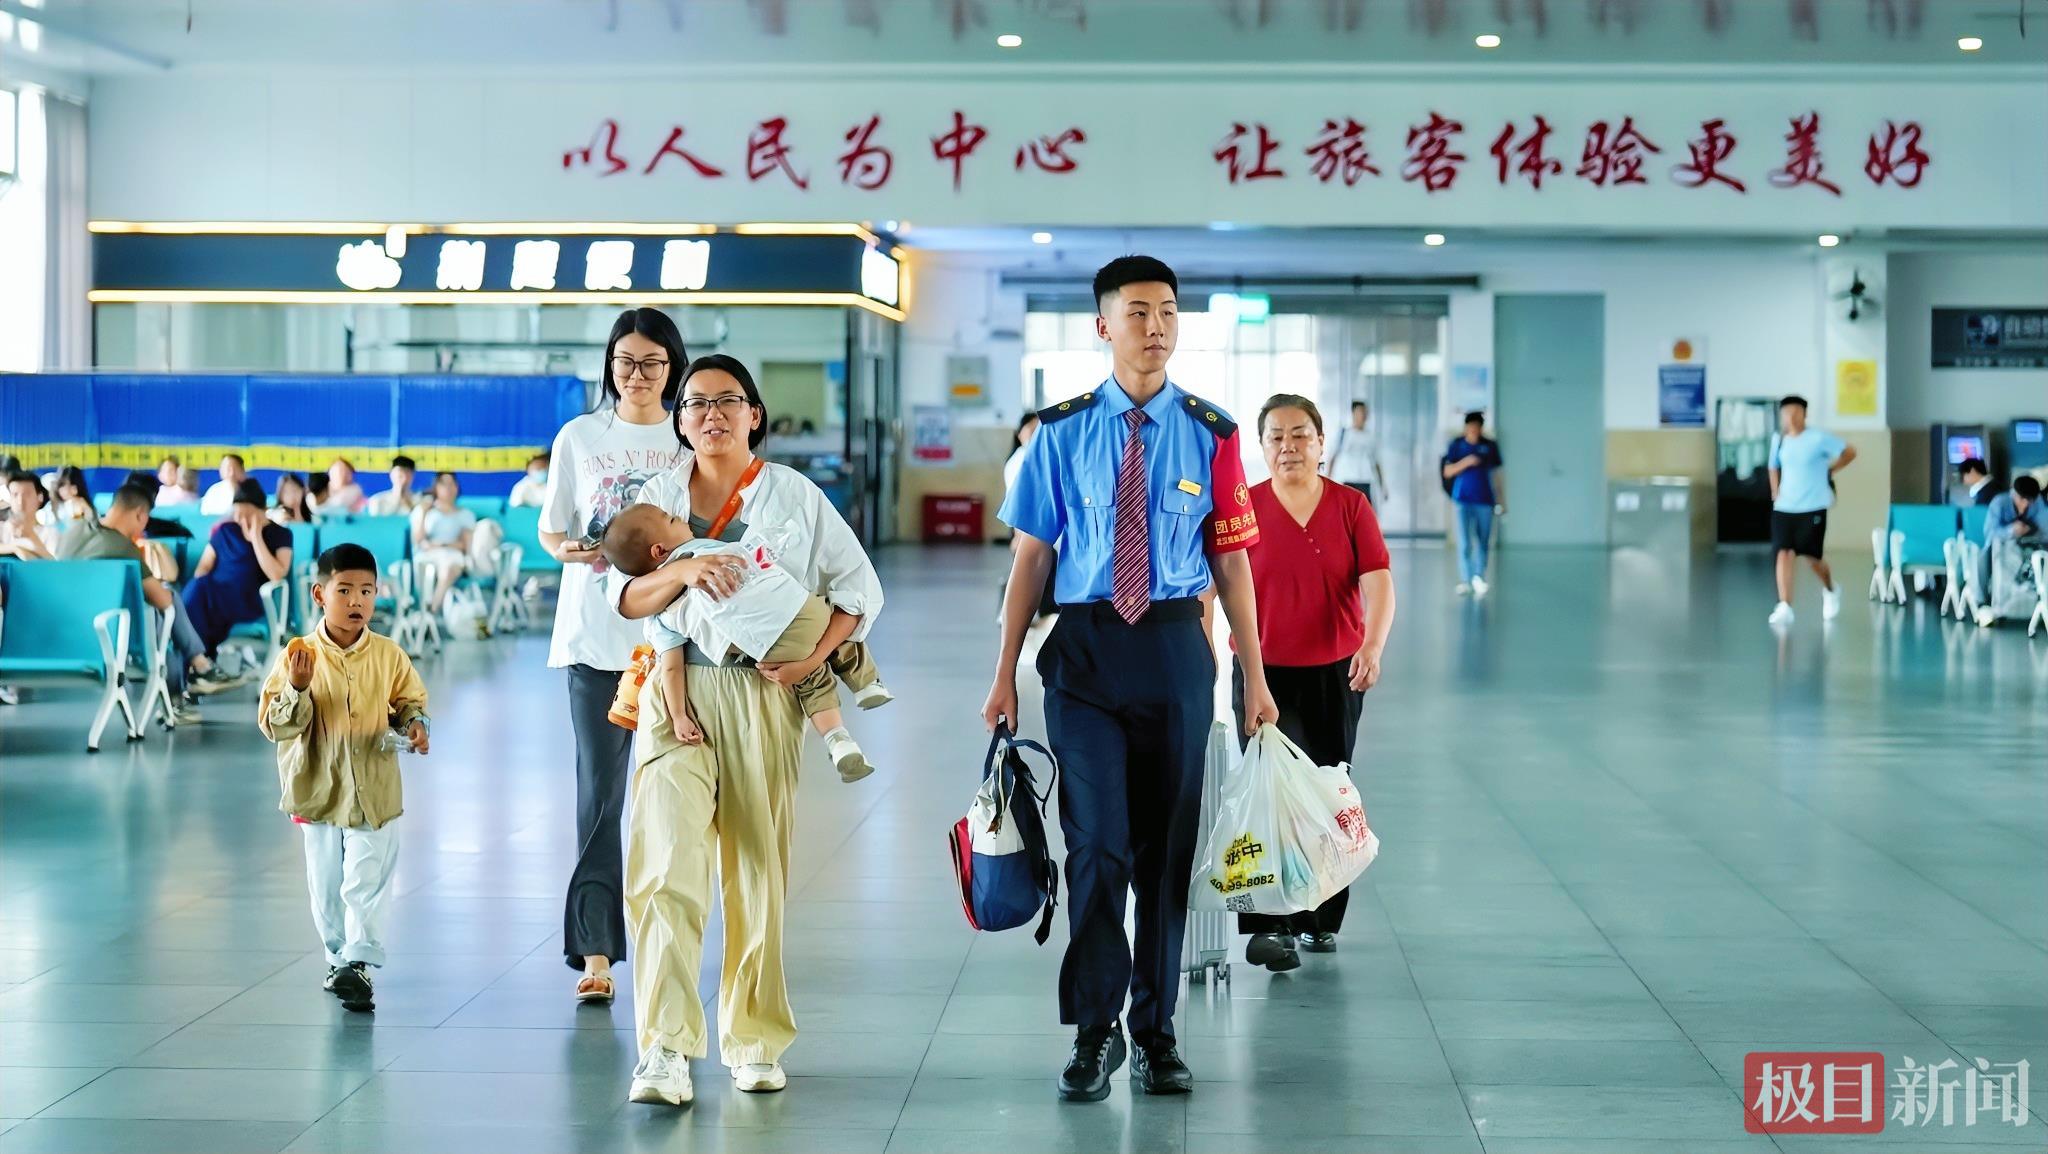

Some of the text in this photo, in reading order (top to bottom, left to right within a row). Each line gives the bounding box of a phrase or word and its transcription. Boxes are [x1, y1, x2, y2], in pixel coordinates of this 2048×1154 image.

[562, 110, 1931, 197] 以人民为中心 让旅客体验更美好
[1215, 510, 1257, 534] 团员先
